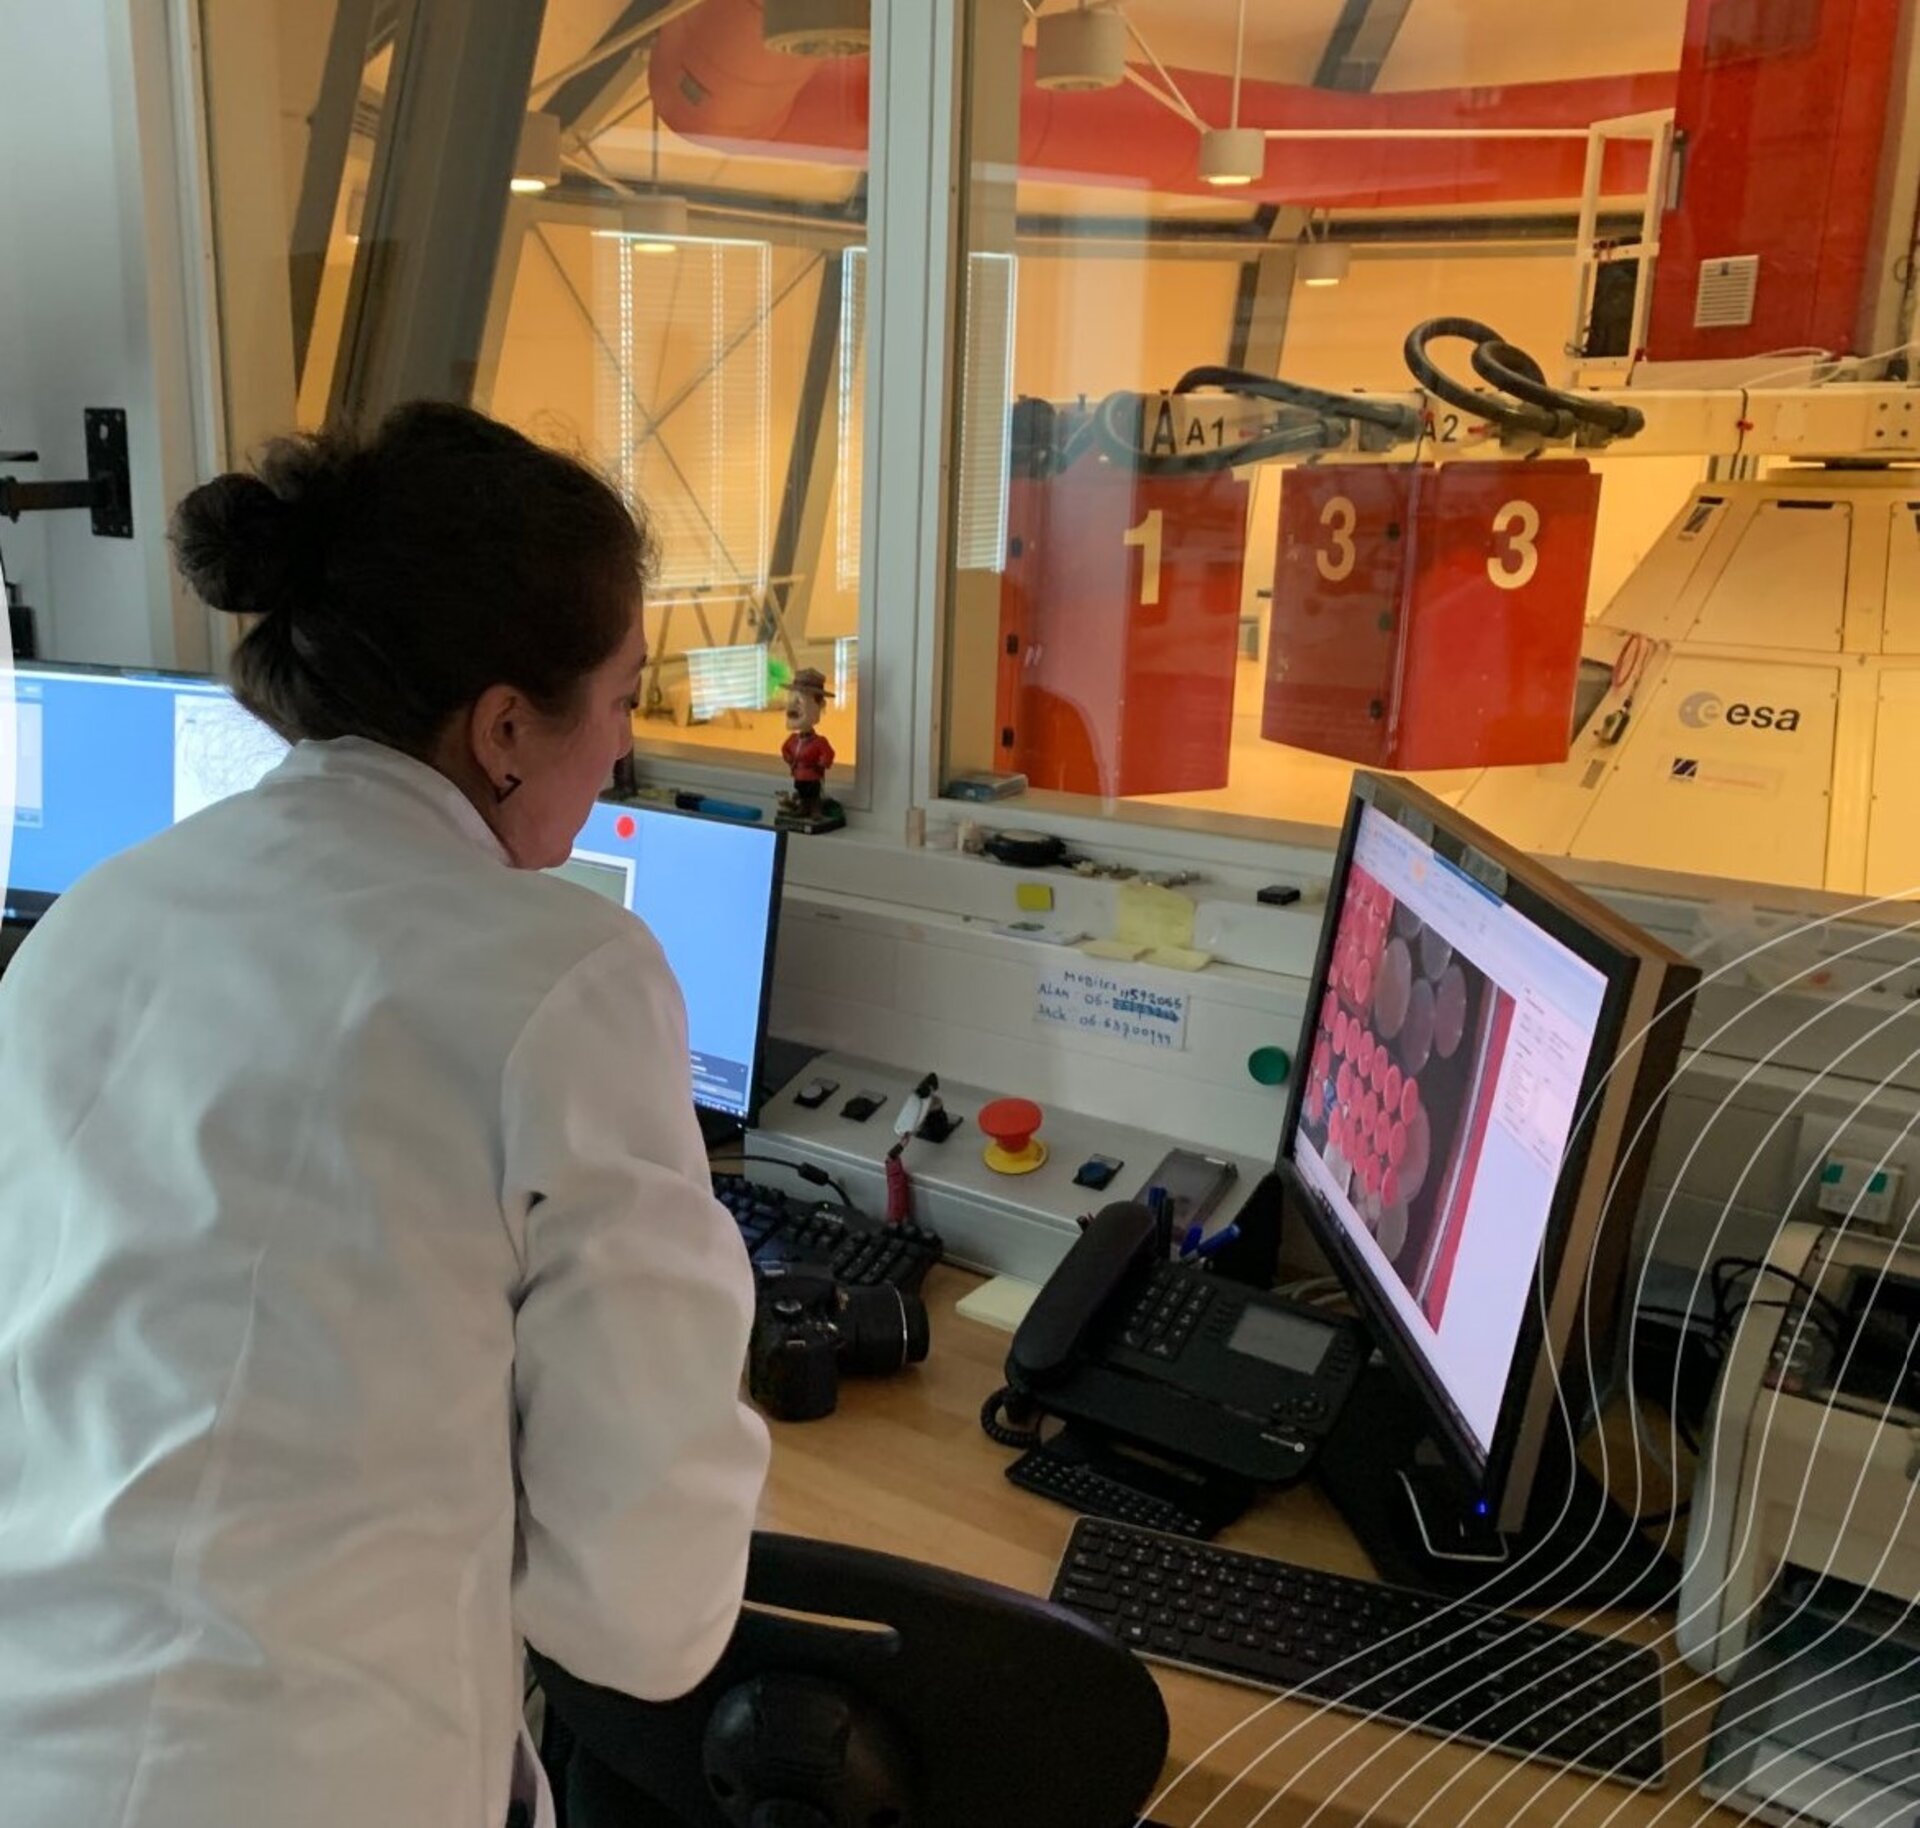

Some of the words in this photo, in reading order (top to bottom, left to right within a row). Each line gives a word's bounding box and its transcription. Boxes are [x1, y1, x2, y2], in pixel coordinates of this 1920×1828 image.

[1150, 399, 1177, 455] A
[1185, 415, 1224, 448] A1
[1421, 412, 1459, 443] A2
[1123, 509, 1163, 606] 1
[1316, 496, 1357, 582] 3
[1486, 500, 1541, 590] 3
[1725, 702, 1801, 732] esa
